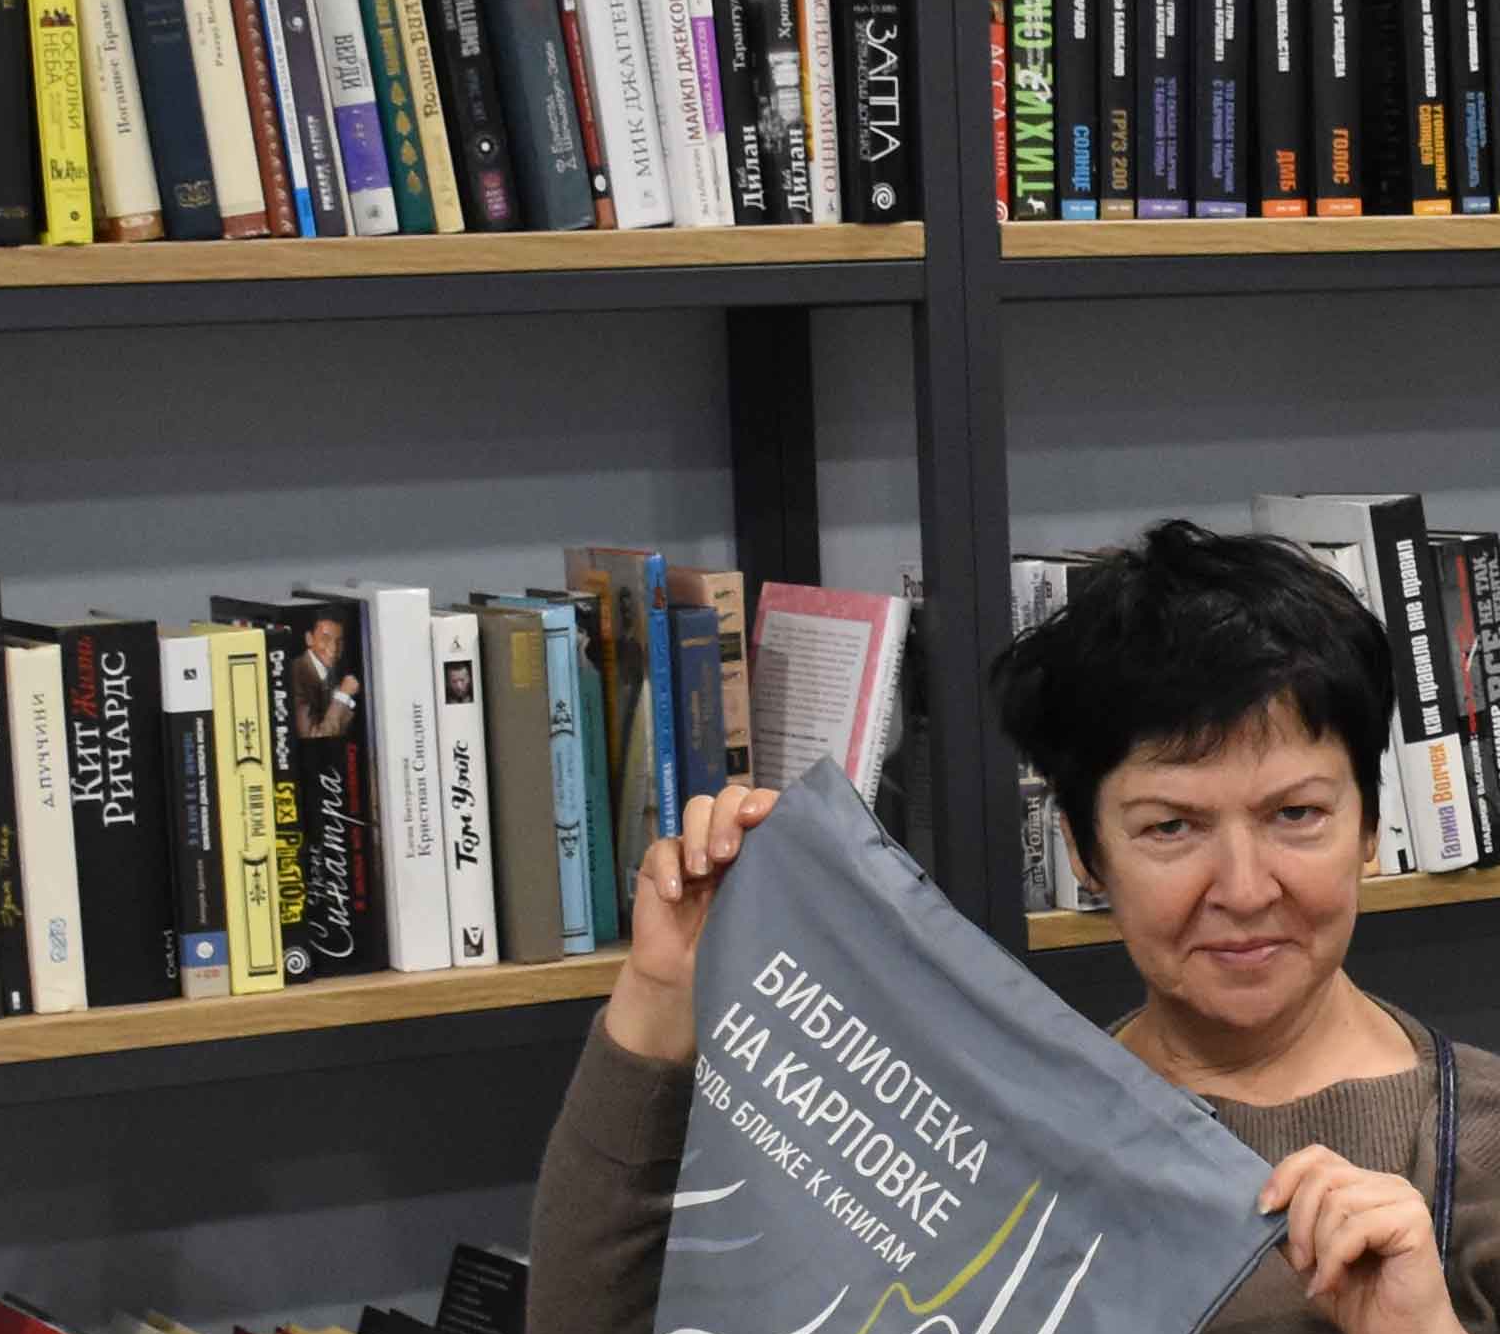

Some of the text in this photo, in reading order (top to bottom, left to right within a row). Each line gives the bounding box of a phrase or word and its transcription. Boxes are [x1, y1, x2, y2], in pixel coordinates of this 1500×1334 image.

[65, 31, 81, 129] ОСКОЛКИ
[334, 33, 365, 91] ВЕРДИ
[866, 19, 899, 160] ЗАППА
[629, 118, 652, 177] МИК
[681, 78, 701, 141] МАЙКЛ
[1016, 62, 1054, 196] ТИХИЕ
[1111, 110, 1128, 189] ГРУЗ 200
[740, 124, 765, 210] Дилан
[787, 128, 811, 213] Дилан
[1072, 125, 1089, 191] СОЛНЦЕ
[1276, 150, 1296, 191] ДМБ
[1332, 129, 1350, 183] ГОЛОС
[1479, 599, 1493, 624] НЕ
[1396, 539, 1463, 859] Галина Волчек как правило вне правил
[752, 952, 988, 1185] БИБЛИОТЕКА
[712, 1002, 961, 1238] НА КАРПОВКЕ
[695, 1055, 916, 1272] БУДЬ БЛИЖЕ К КНИГАМ
